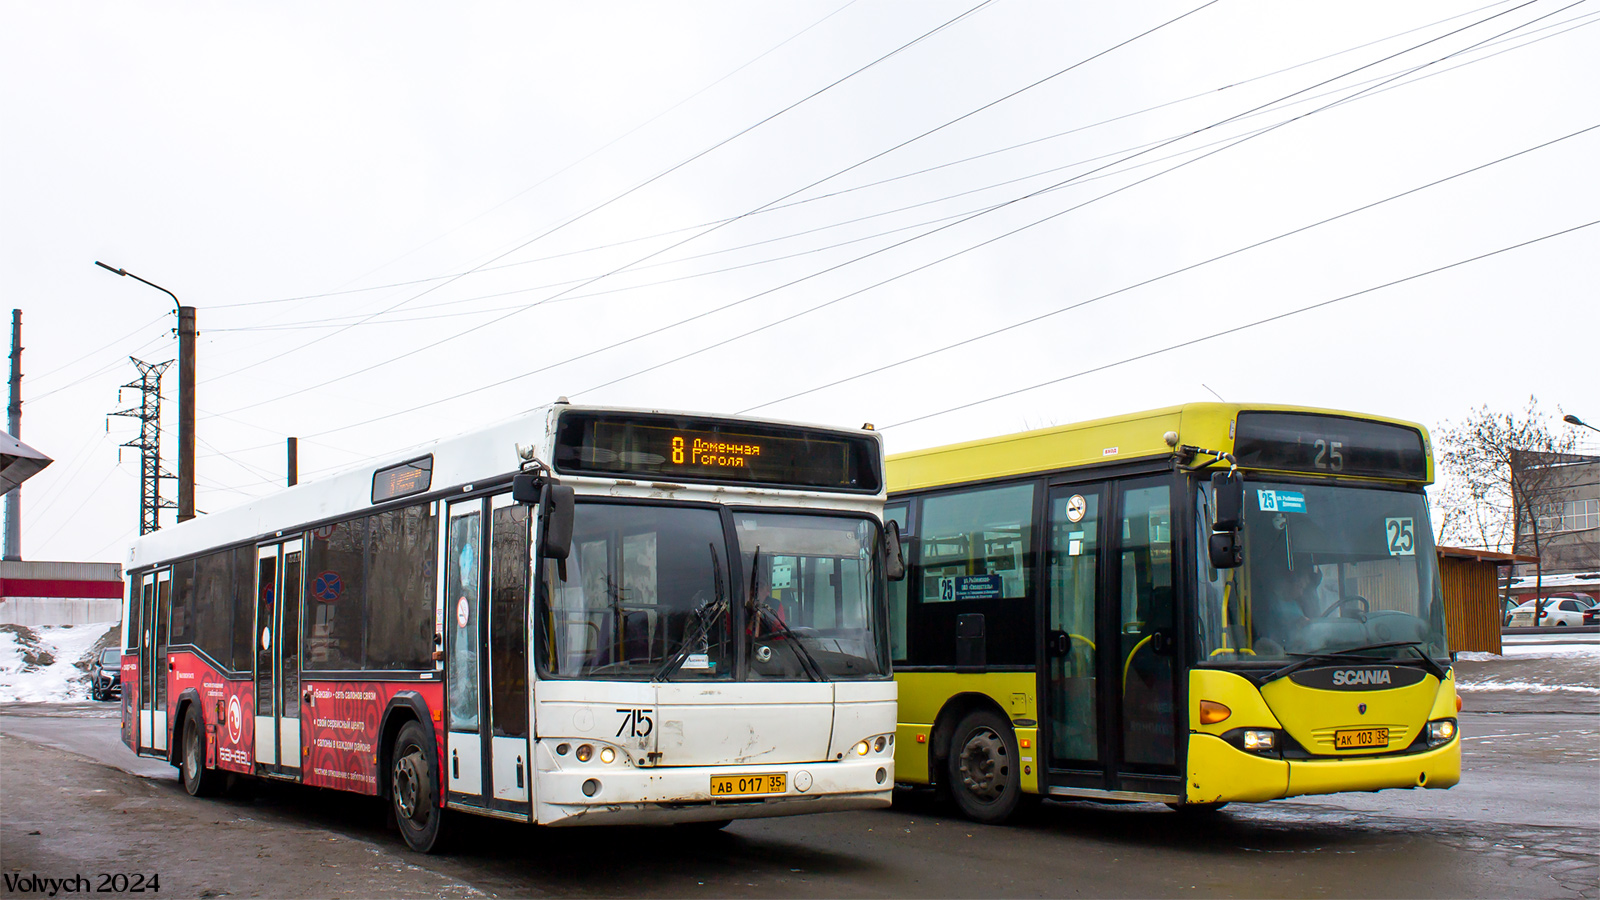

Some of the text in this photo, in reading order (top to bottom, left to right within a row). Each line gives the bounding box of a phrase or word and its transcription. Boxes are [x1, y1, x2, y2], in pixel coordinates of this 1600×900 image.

[672, 436, 684, 464] 8
[1313, 439, 1343, 472] 25
[1261, 492, 1275, 509] 25
[1387, 520, 1414, 552] 25
[941, 579, 953, 600] 25
[1332, 670, 1392, 686] SCANIA
[616, 709, 653, 738] 715
[1341, 730, 1386, 746] АК 103 35
[717, 776, 782, 793] АВ 017 35
